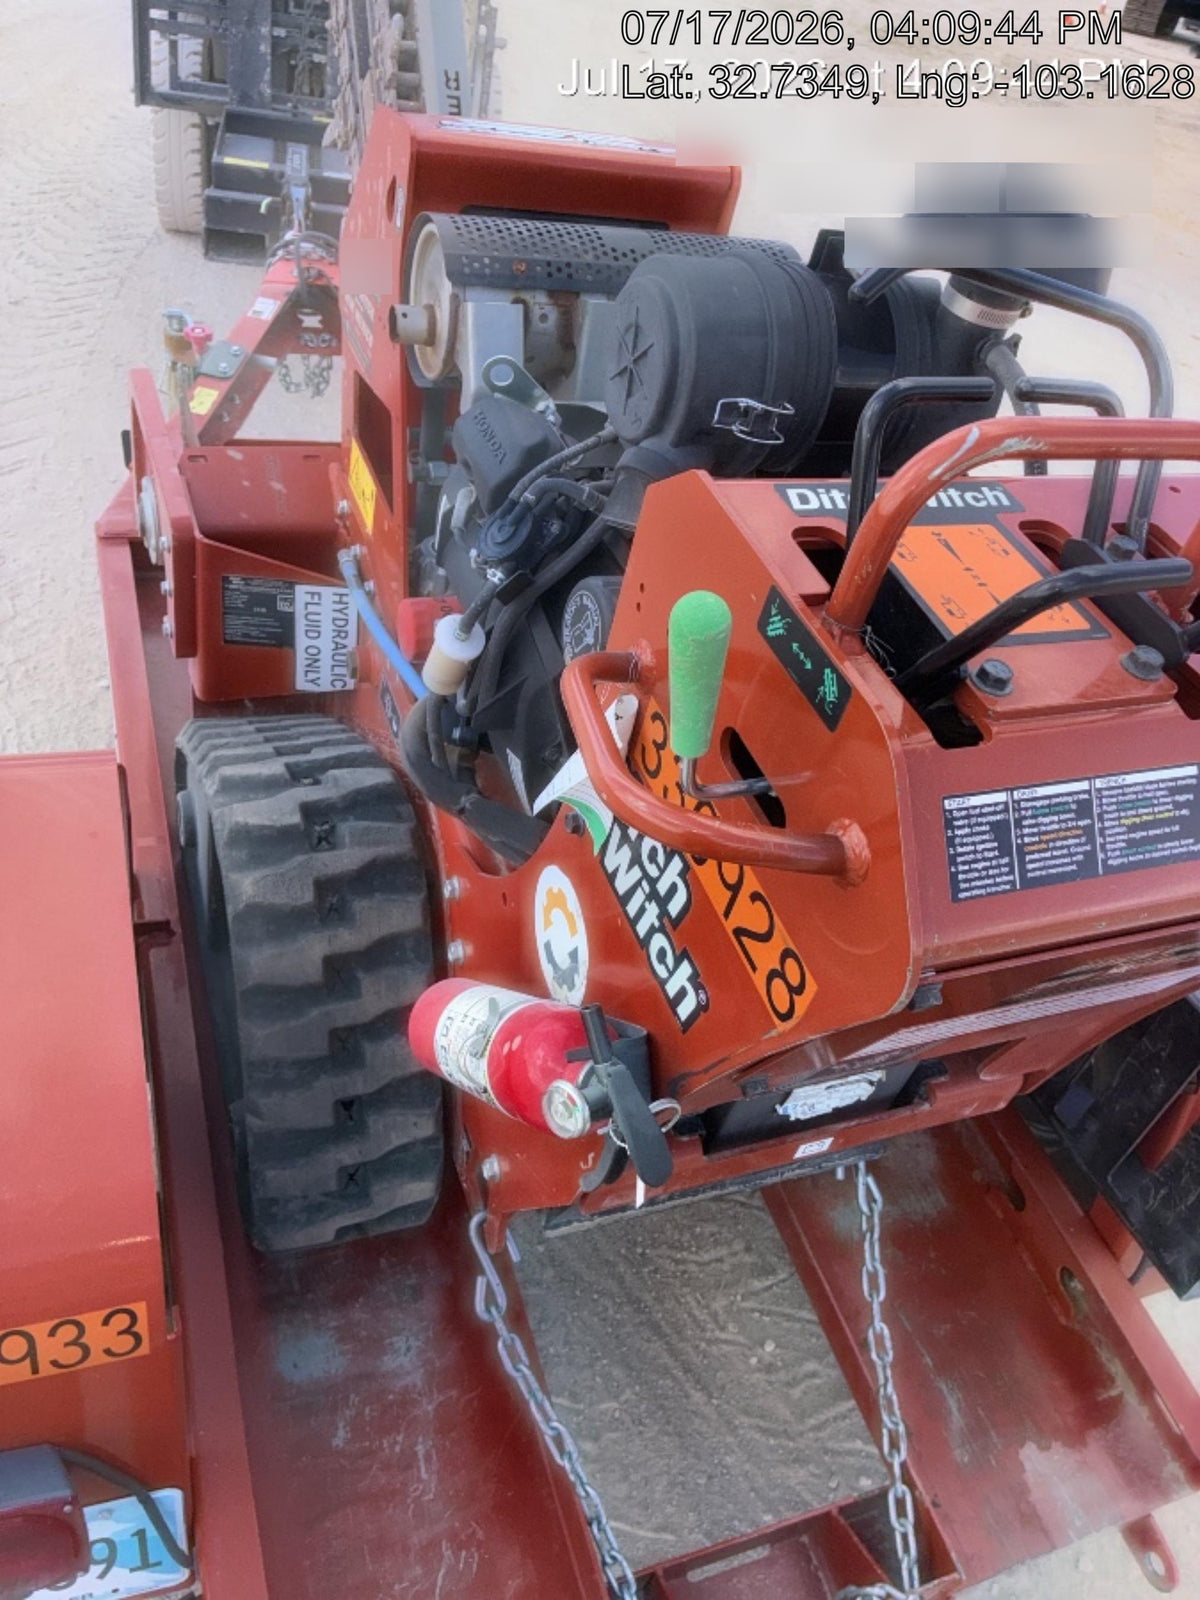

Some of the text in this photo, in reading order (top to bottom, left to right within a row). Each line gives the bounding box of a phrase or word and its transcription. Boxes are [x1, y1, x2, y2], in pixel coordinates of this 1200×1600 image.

[474, 411, 508, 464] HONDA
[786, 487, 850, 510] Dit
[304, 591, 322, 687] FLUID ONLY
[330, 592, 350, 689] HYDRAULIC
[642, 711, 806, 1022] 3928
[0, 1307, 143, 1376] 933
